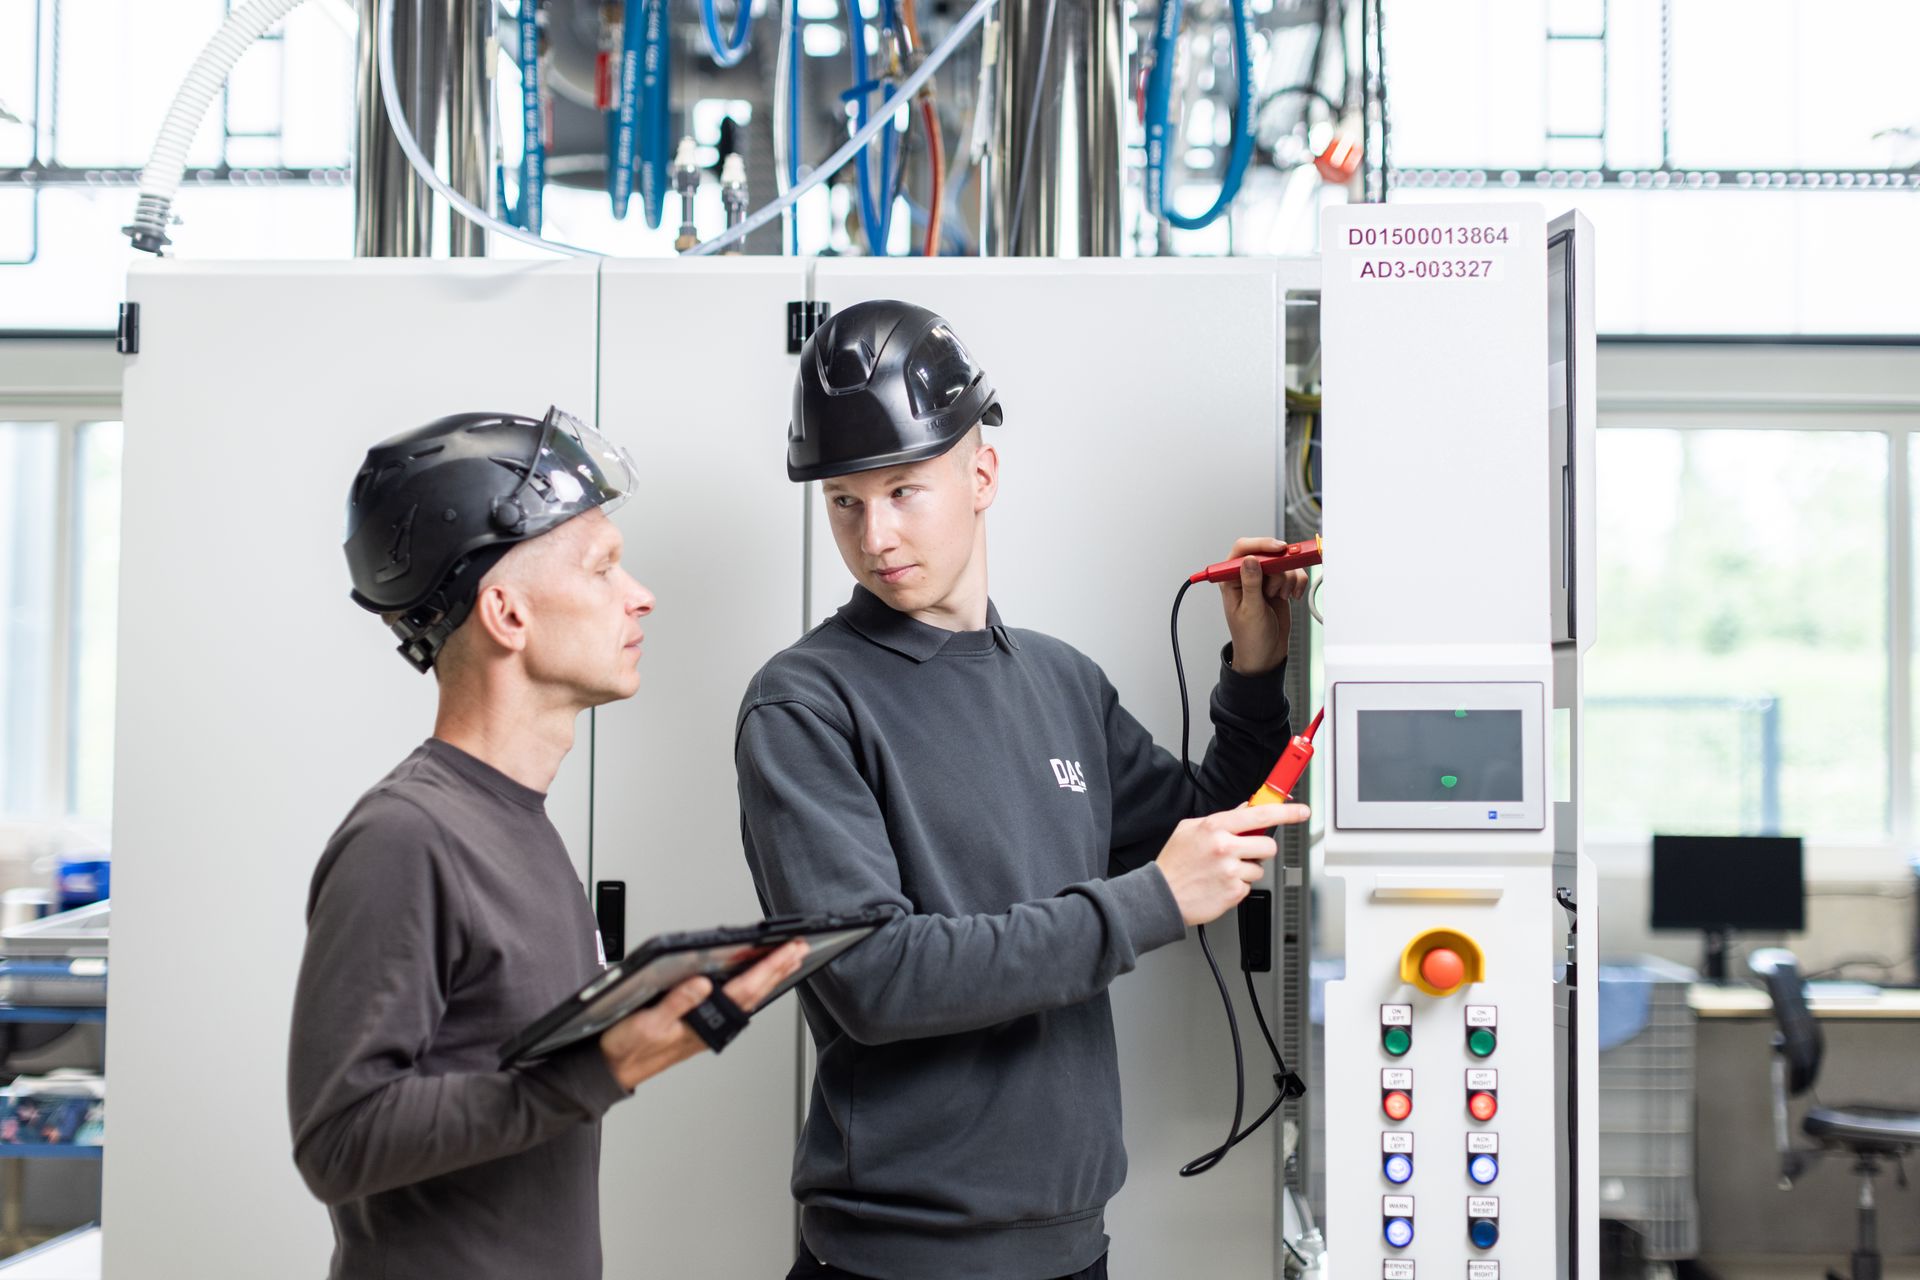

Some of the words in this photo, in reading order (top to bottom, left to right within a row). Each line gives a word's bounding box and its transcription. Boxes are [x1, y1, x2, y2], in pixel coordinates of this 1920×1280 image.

[1348, 227, 1509, 245] D01500013864
[1360, 260, 1493, 279] AD3-003327
[1049, 758, 1087, 788] DAS
